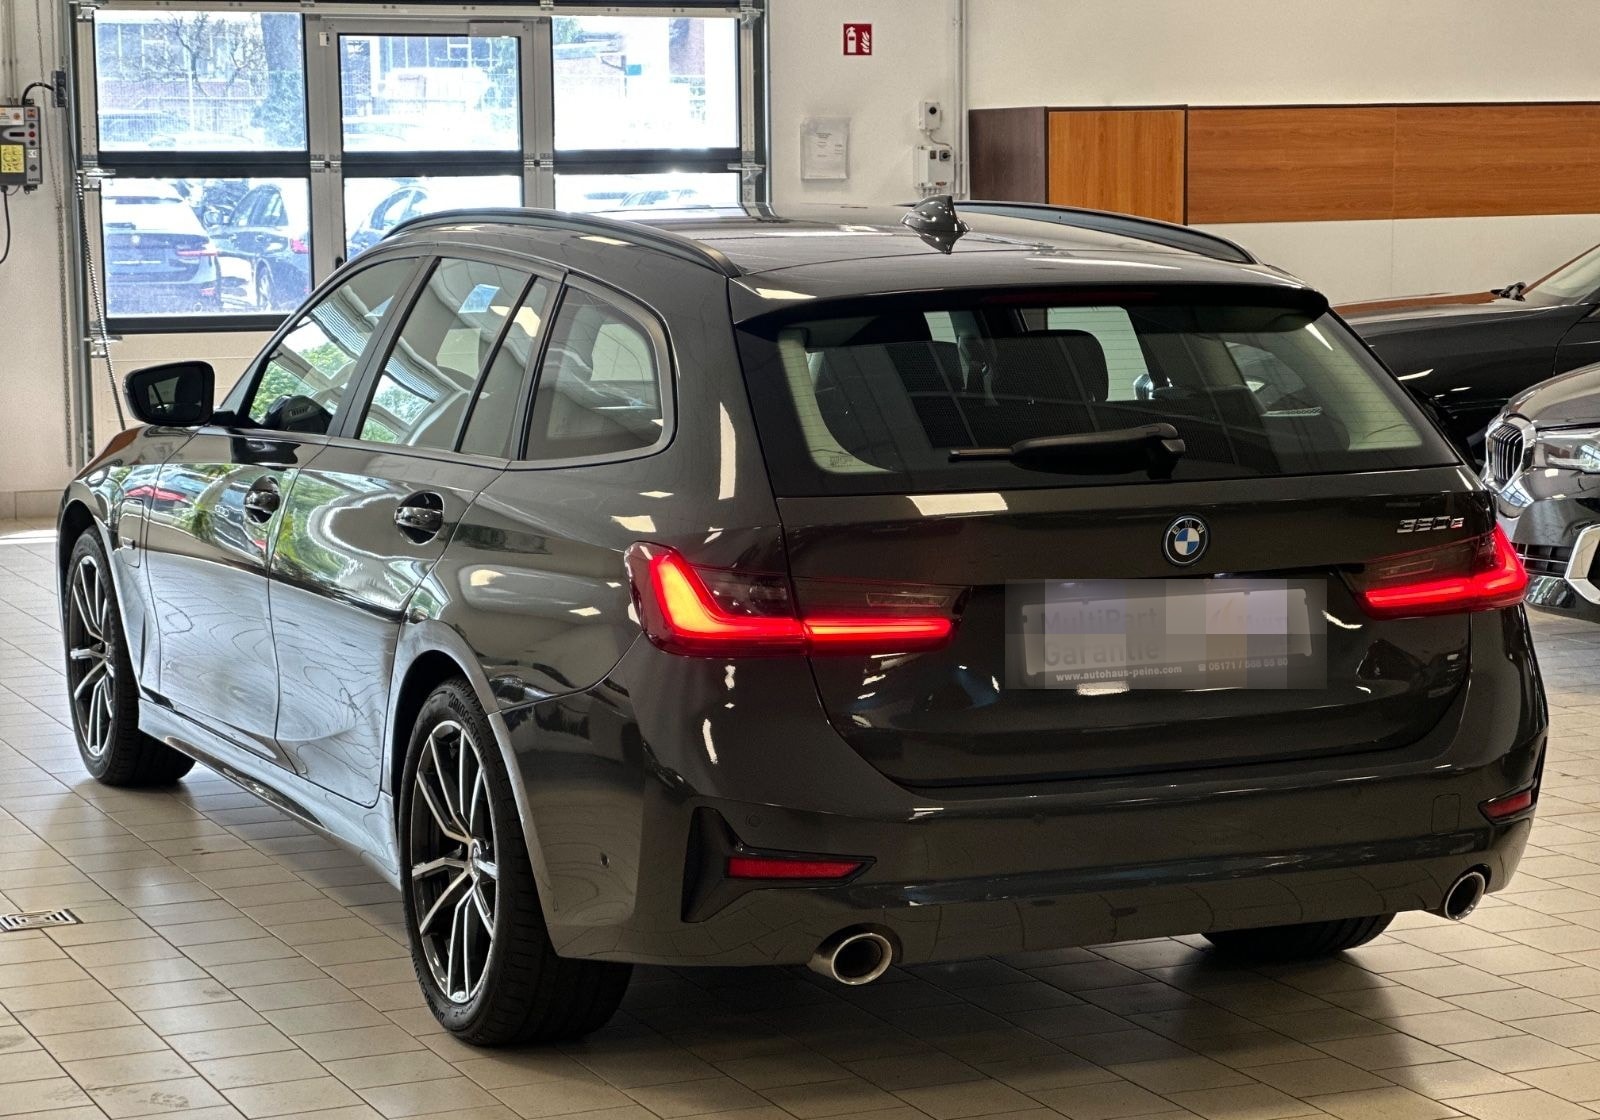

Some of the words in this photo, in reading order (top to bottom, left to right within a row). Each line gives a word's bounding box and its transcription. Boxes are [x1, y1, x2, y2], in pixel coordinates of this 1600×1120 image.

[1396, 515, 1465, 534] 320e
[1055, 666, 1182, 682] www.autohaus-peine.com
[1208, 661, 1236, 671] 05171
